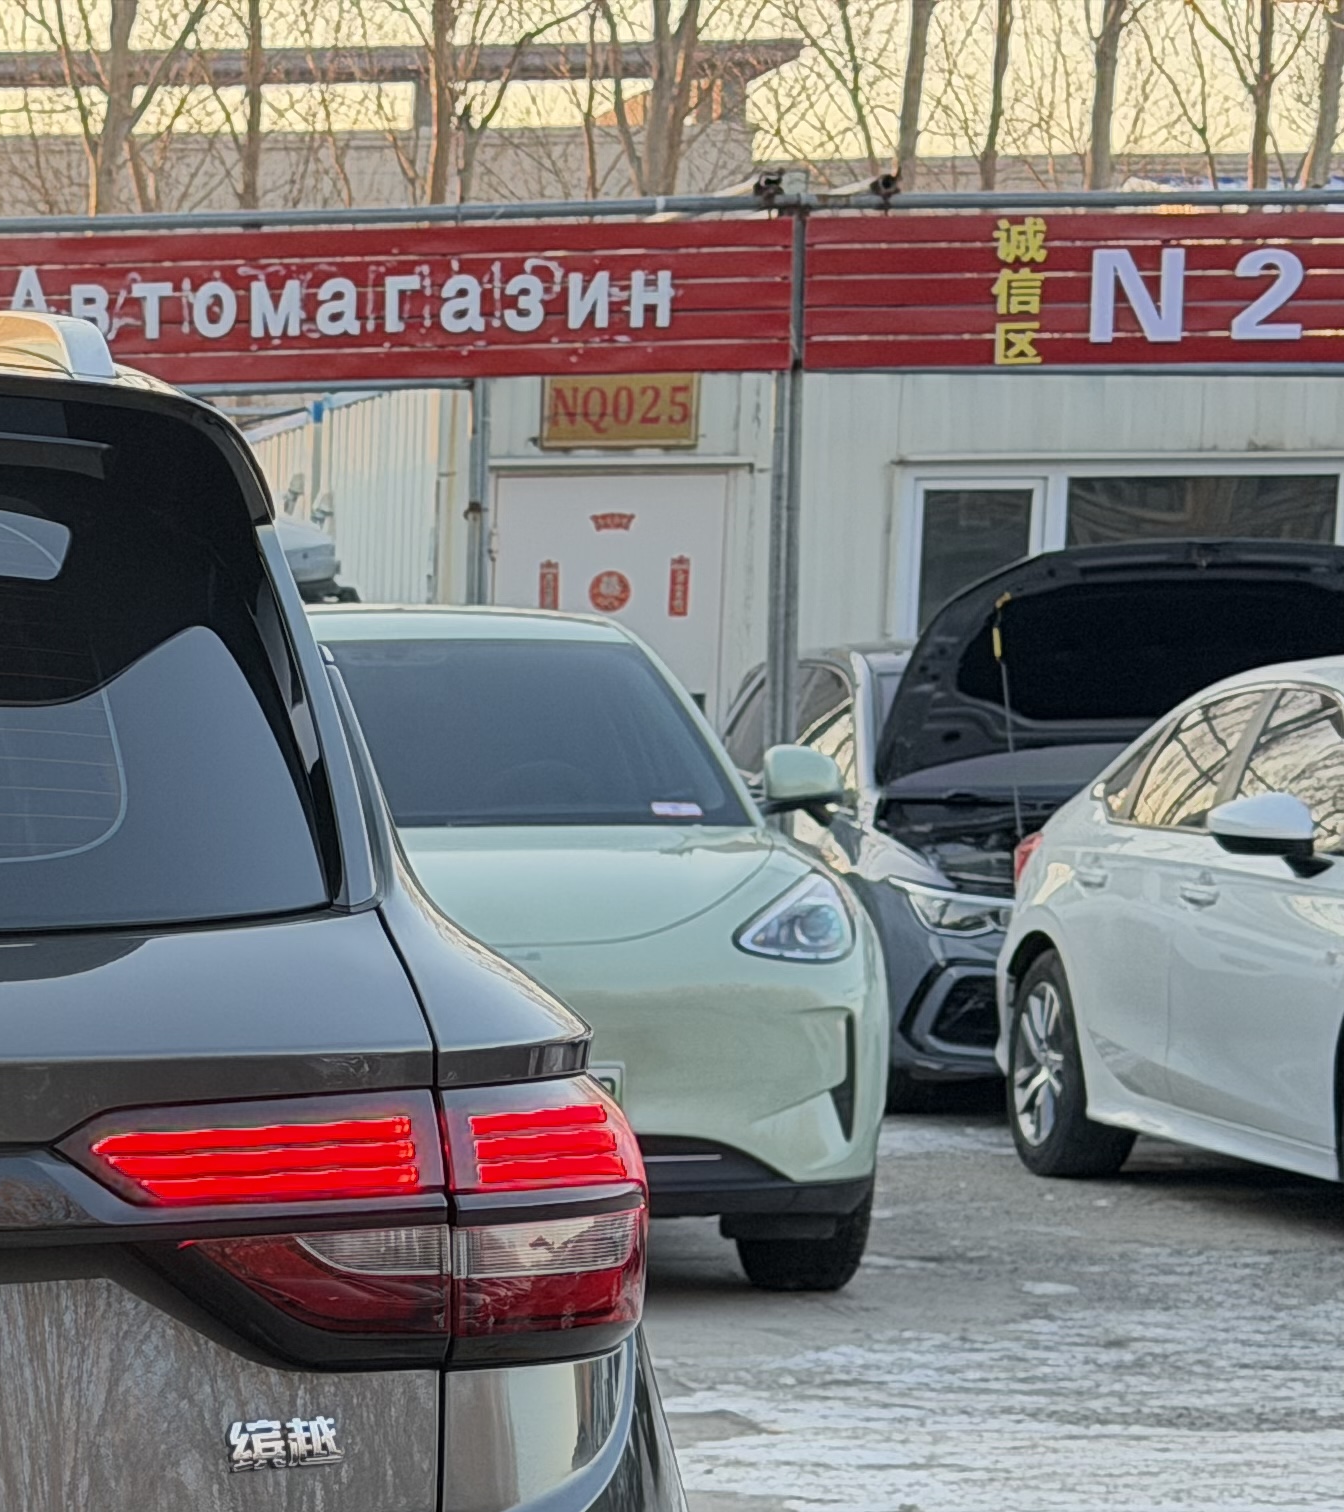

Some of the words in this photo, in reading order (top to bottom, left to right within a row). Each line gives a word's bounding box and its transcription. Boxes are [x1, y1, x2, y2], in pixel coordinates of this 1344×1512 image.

[10, 265, 674, 340] Автомагазин
[991, 216, 1048, 365] 诚信区
[1089, 248, 1304, 343] N2
[551, 384, 690, 434] NQ025
[228, 1415, 344, 1472] 缤越
